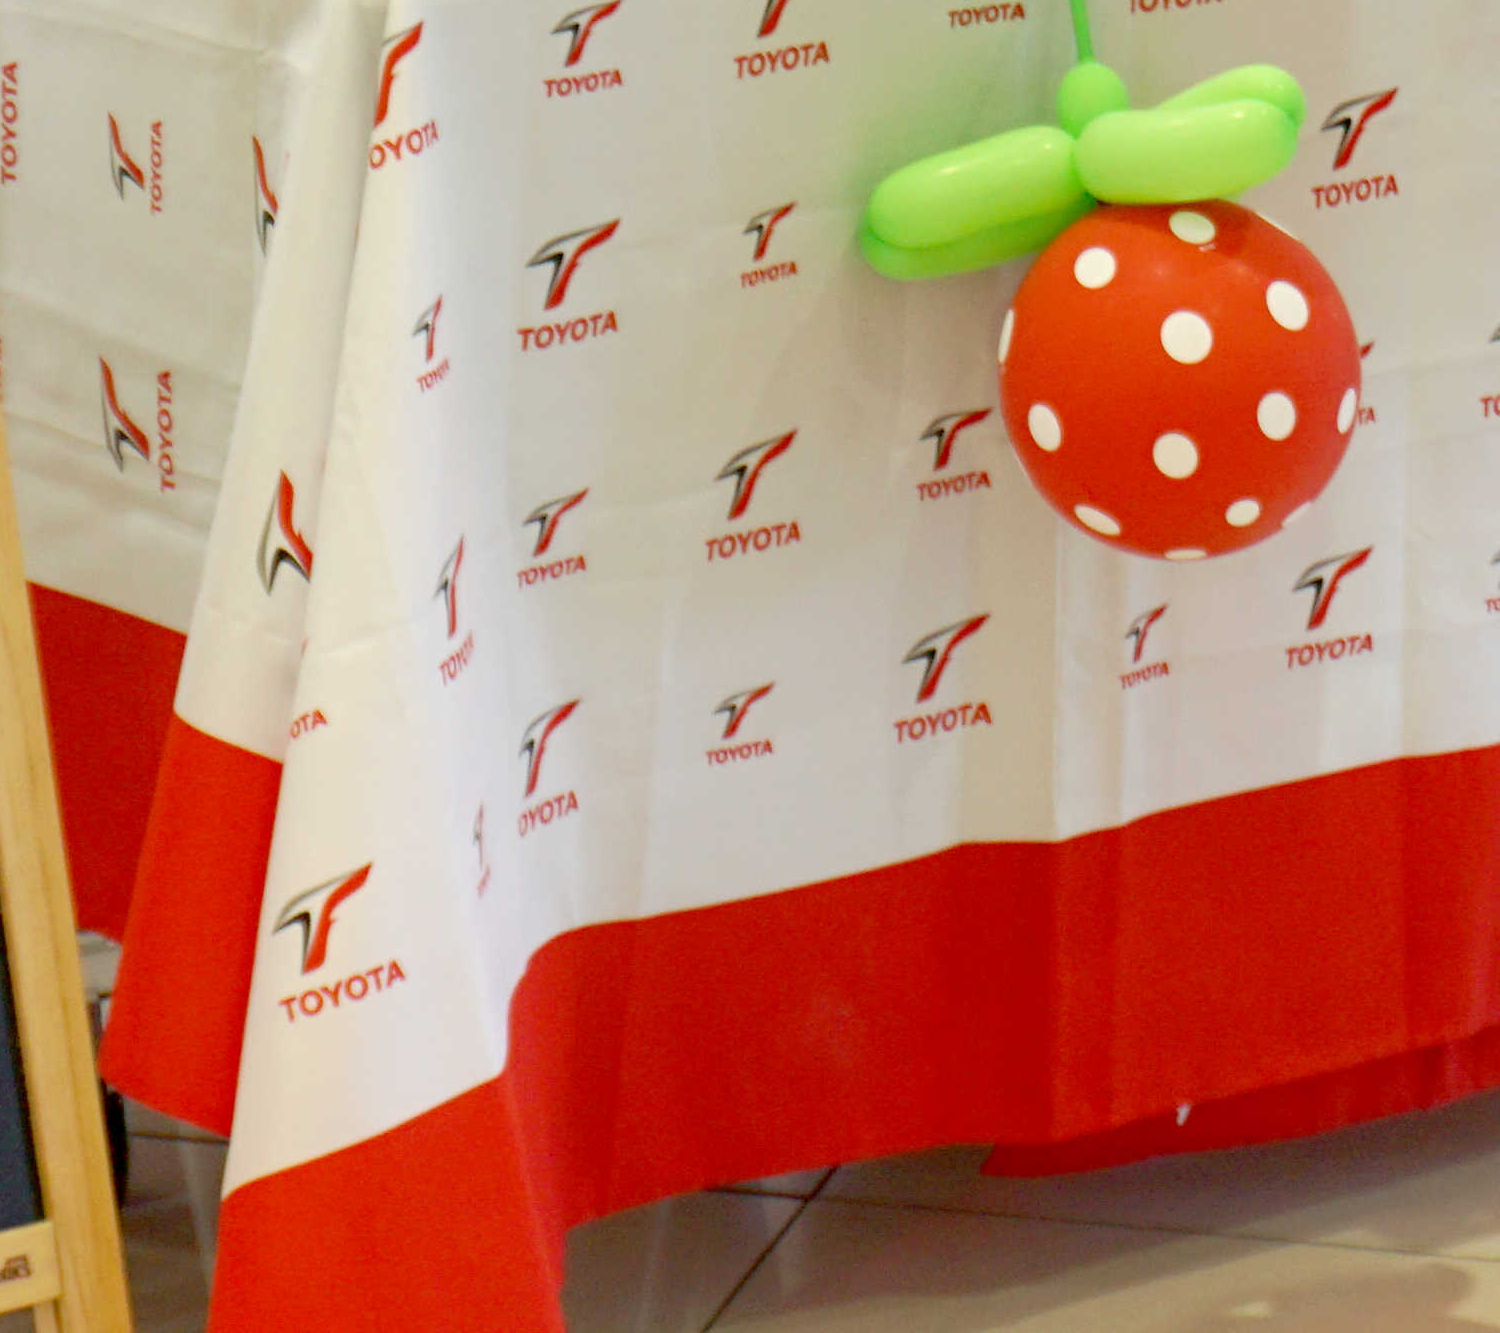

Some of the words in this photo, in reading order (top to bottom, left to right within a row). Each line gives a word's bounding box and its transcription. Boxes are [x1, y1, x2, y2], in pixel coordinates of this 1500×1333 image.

[948, 1, 1026, 27] TOYOTA
[734, 40, 830, 78] TOYOTA
[544, 68, 624, 97] TOYOTA
[0, 61, 19, 182] TOYOTA
[369, 120, 439, 169] OYOTA
[150, 119, 165, 212] TOYOTA
[1311, 173, 1400, 209] TOYOTA
[740, 260, 799, 286] TOYOTA
[517, 309, 619, 350] TOYOTA
[157, 369, 177, 489] TOYOTA
[916, 469, 993, 499] TOYOTA
[704, 519, 803, 561] TOYOTA
[517, 555, 588, 585] TOYOTA
[1286, 632, 1374, 668] TOYOTA
[1118, 660, 1171, 687] TOYOTA
[289, 708, 328, 739] OTA
[894, 701, 993, 742] TOYOTA
[706, 737, 774, 764] TOYOTA
[279, 960, 405, 1022] TOYOTA
